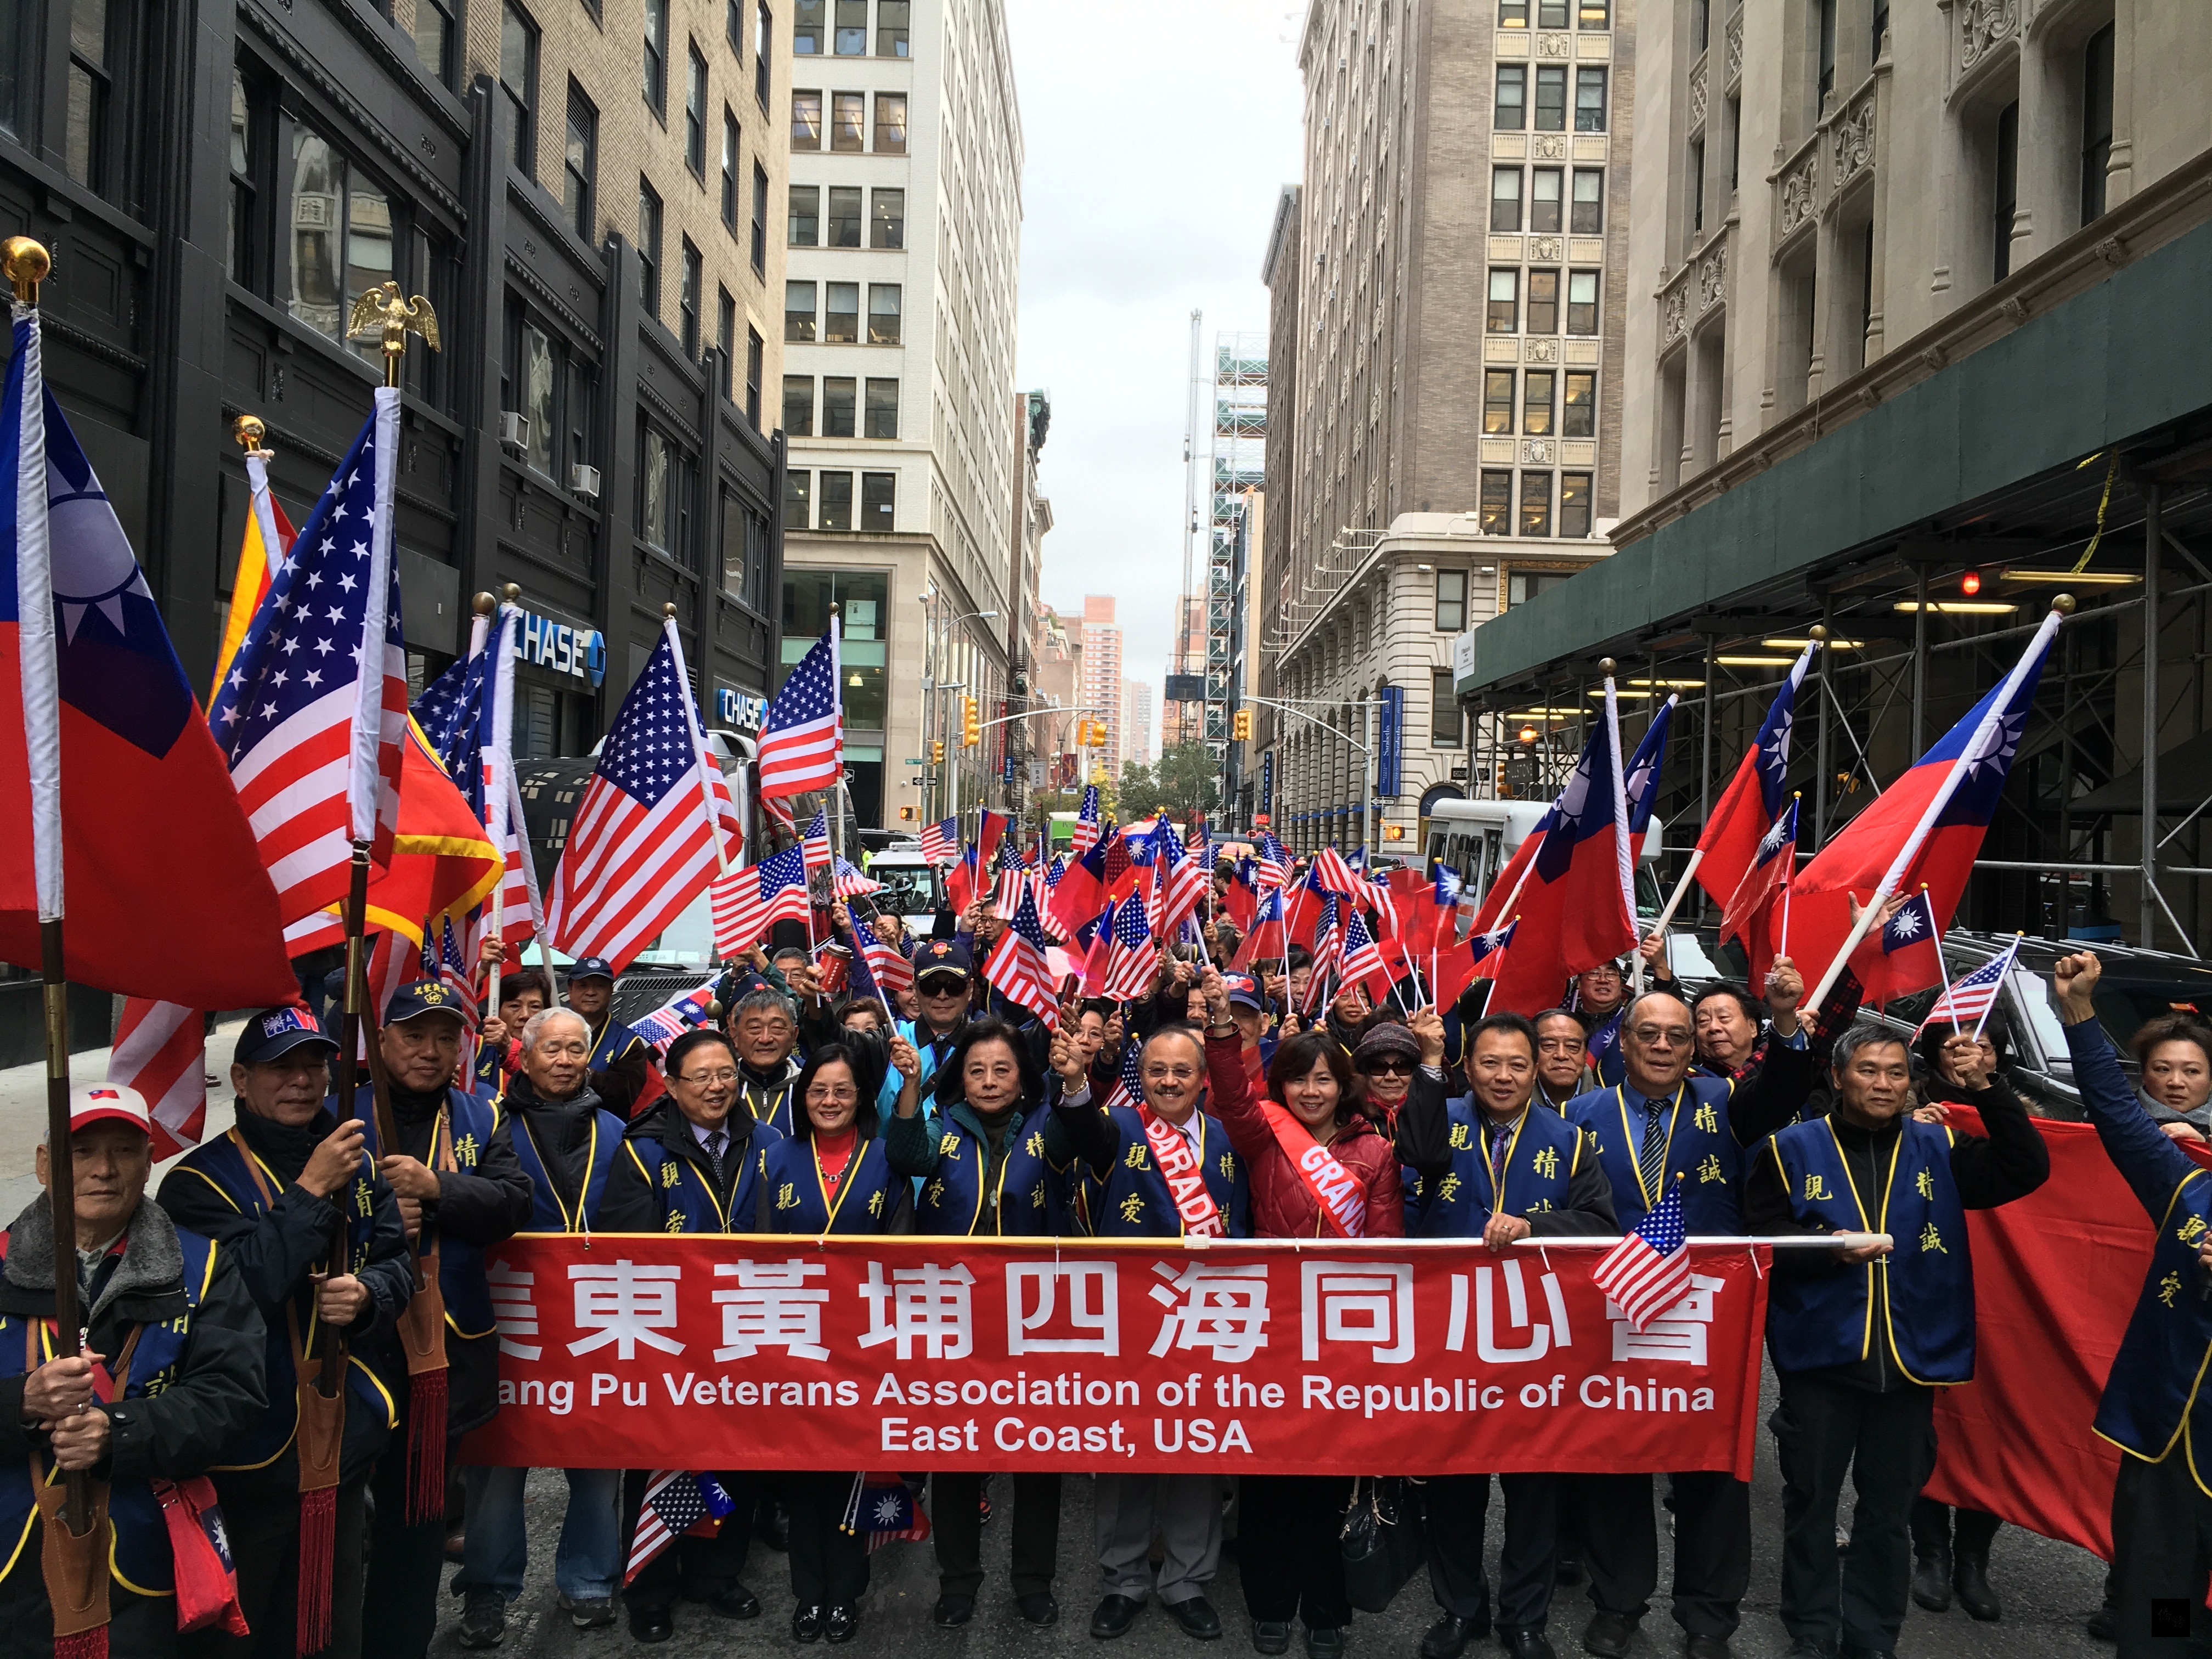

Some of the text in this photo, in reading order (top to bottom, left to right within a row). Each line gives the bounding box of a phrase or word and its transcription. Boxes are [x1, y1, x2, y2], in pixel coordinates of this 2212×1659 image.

[725, 689, 759, 731] CHASE
[928, 1131, 961, 1207] 親愛
[1120, 1142, 1151, 1224] 親愛
[1146, 1116, 1222, 1237] PARADE
[1438, 1122, 1473, 1203] 親愛
[1694, 1102, 1726, 1185] 精誠
[1301, 1146, 1366, 1237] GRAND
[1916, 1166, 1948, 1254] 精誠
[591, 1373, 646, 1406] Pu
[663, 1373, 859, 1406] Veterans
[872, 1372, 1139, 1406] Association
[1157, 1373, 1202, 1407] of
[1214, 1374, 1285, 1408] the
[1302, 1375, 1504, 1418] Republic
[1519, 1374, 1565, 1408] of
[1579, 1375, 1714, 1412] China
[882, 1417, 1253, 1458] East Coast, USA
